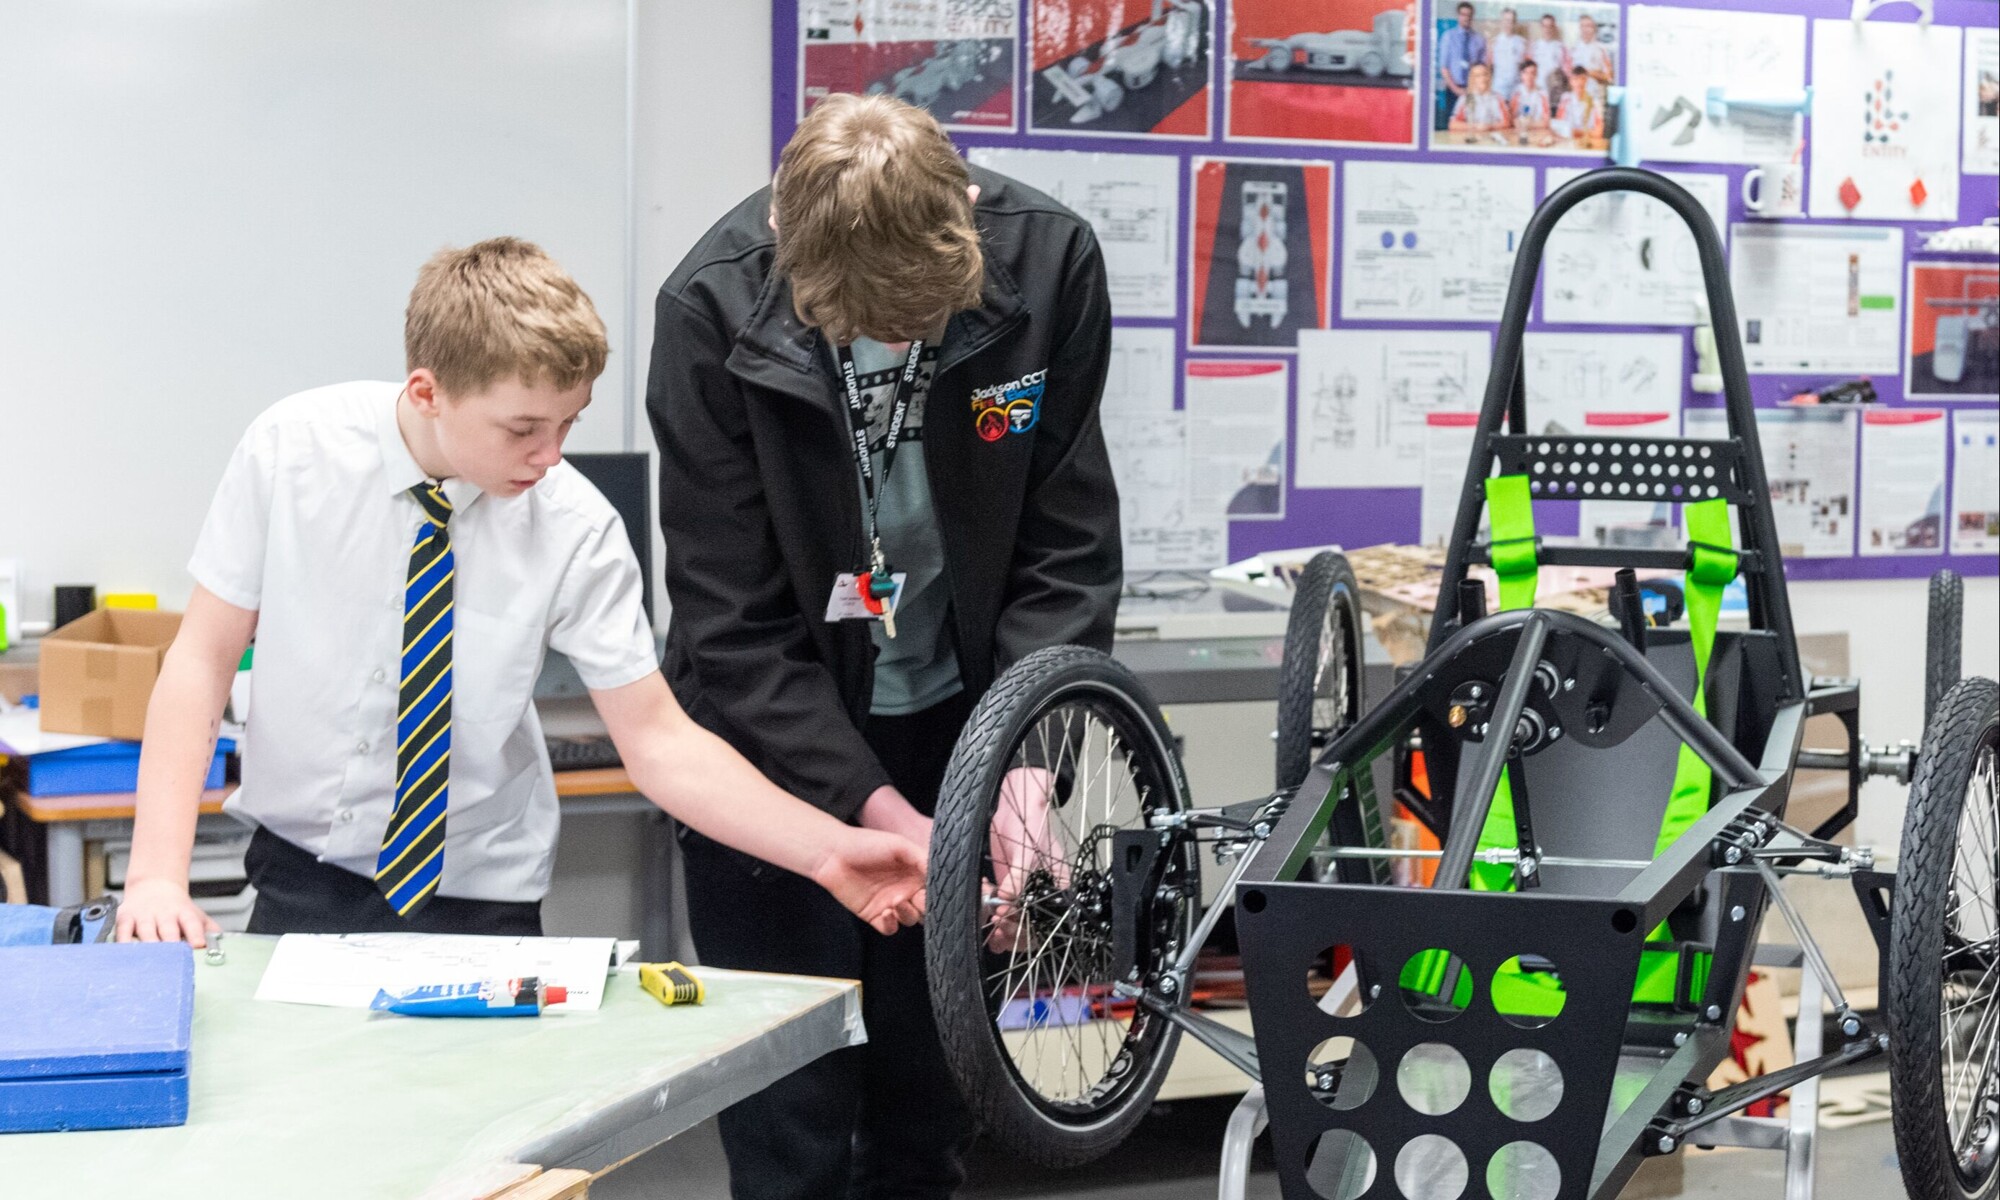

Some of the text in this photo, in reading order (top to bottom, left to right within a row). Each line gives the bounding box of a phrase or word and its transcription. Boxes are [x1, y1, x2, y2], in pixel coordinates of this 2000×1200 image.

[1862, 145, 1908, 159] ENTITY
[903, 340, 923, 383] STUDEN
[843, 360, 861, 410] STUDENT
[971, 368, 1048, 401] Jackson CCT
[971, 398, 995, 412] Fire
[994, 393, 1006, 405] &
[886, 400, 906, 449] STUDENT
[855, 429, 871, 478] STUDENT
